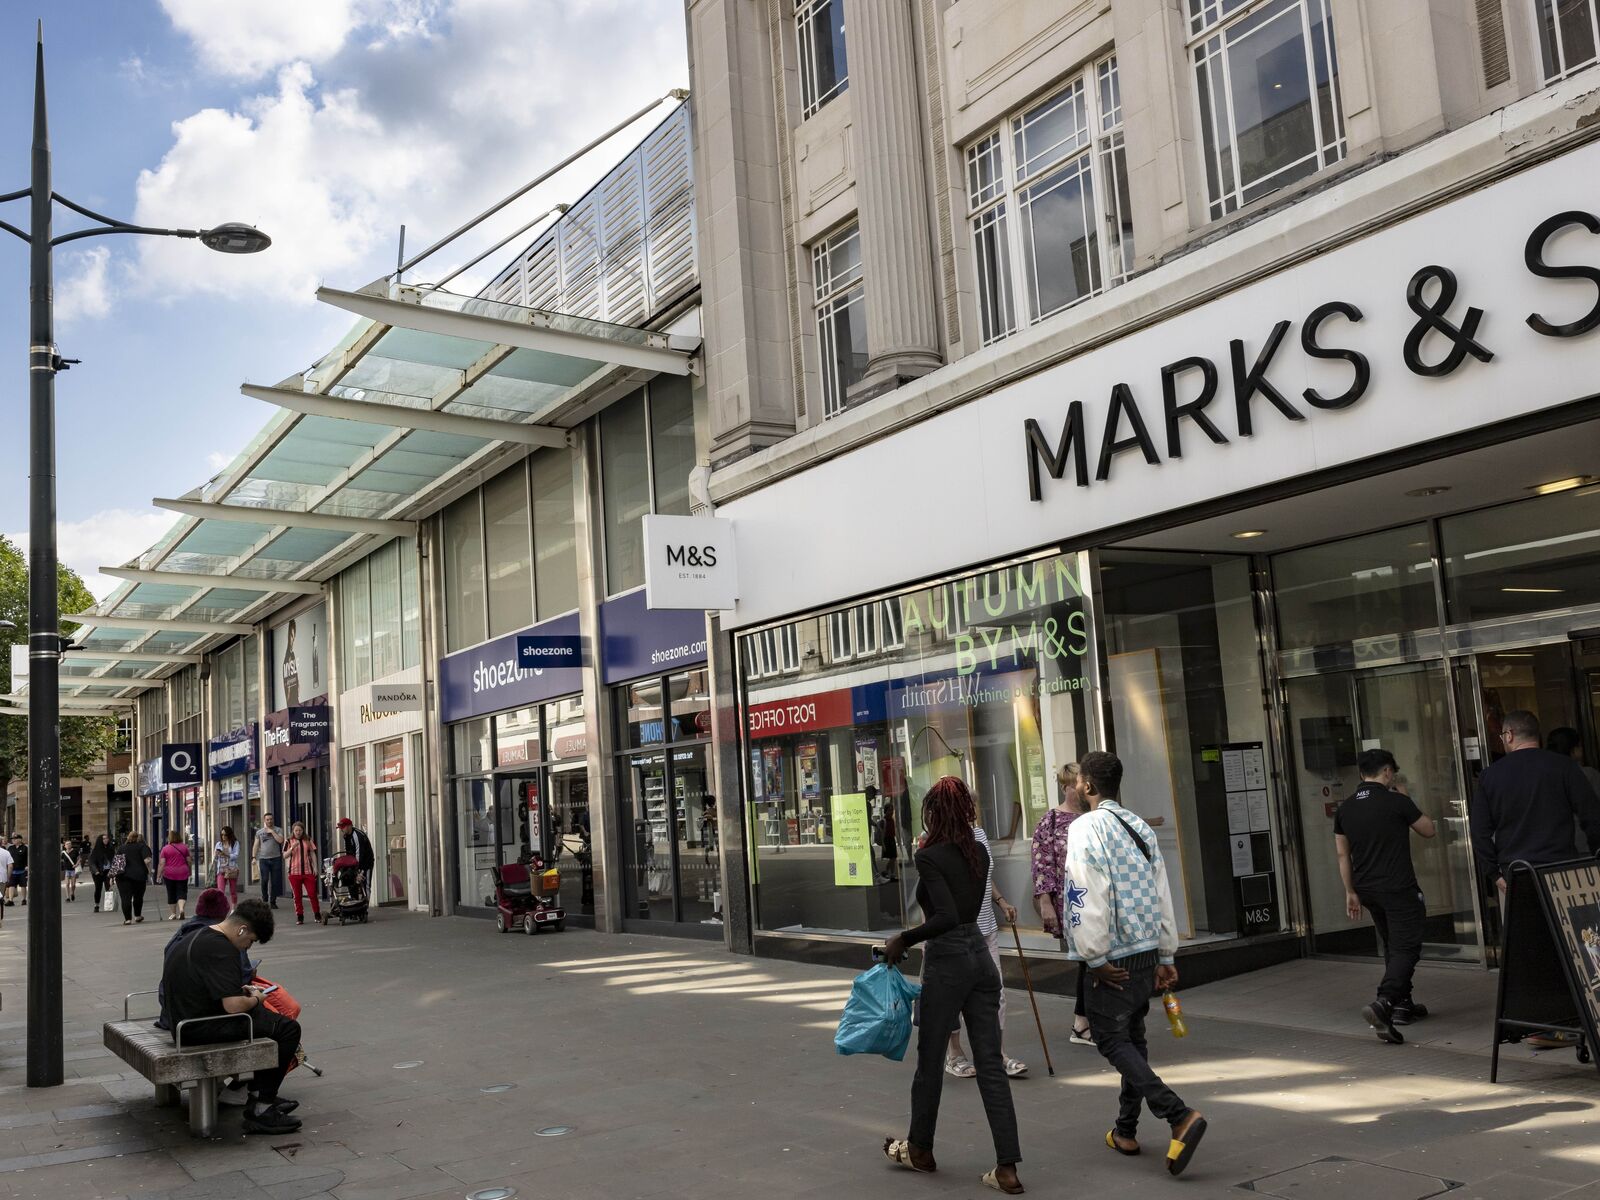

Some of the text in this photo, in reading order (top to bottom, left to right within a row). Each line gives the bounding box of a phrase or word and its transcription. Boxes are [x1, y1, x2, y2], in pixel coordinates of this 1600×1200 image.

[1024, 301, 1371, 502] MARKS
[1403, 265, 1495, 378] &
[666, 544, 717, 568] M&S
[903, 557, 1083, 635] AUTUMN
[523, 645, 573, 656] shoezone
[651, 640, 708, 664] shoezone.com
[955, 610, 1088, 676] BY M&S
[958, 687, 1011, 708] Anything
[1037, 676, 1092, 694] ordinary
[290, 720, 328, 728] Fragrance
[300, 729, 319, 737] Shop
[264, 729, 276, 748] The
[1245, 907, 1271, 925] M&S
